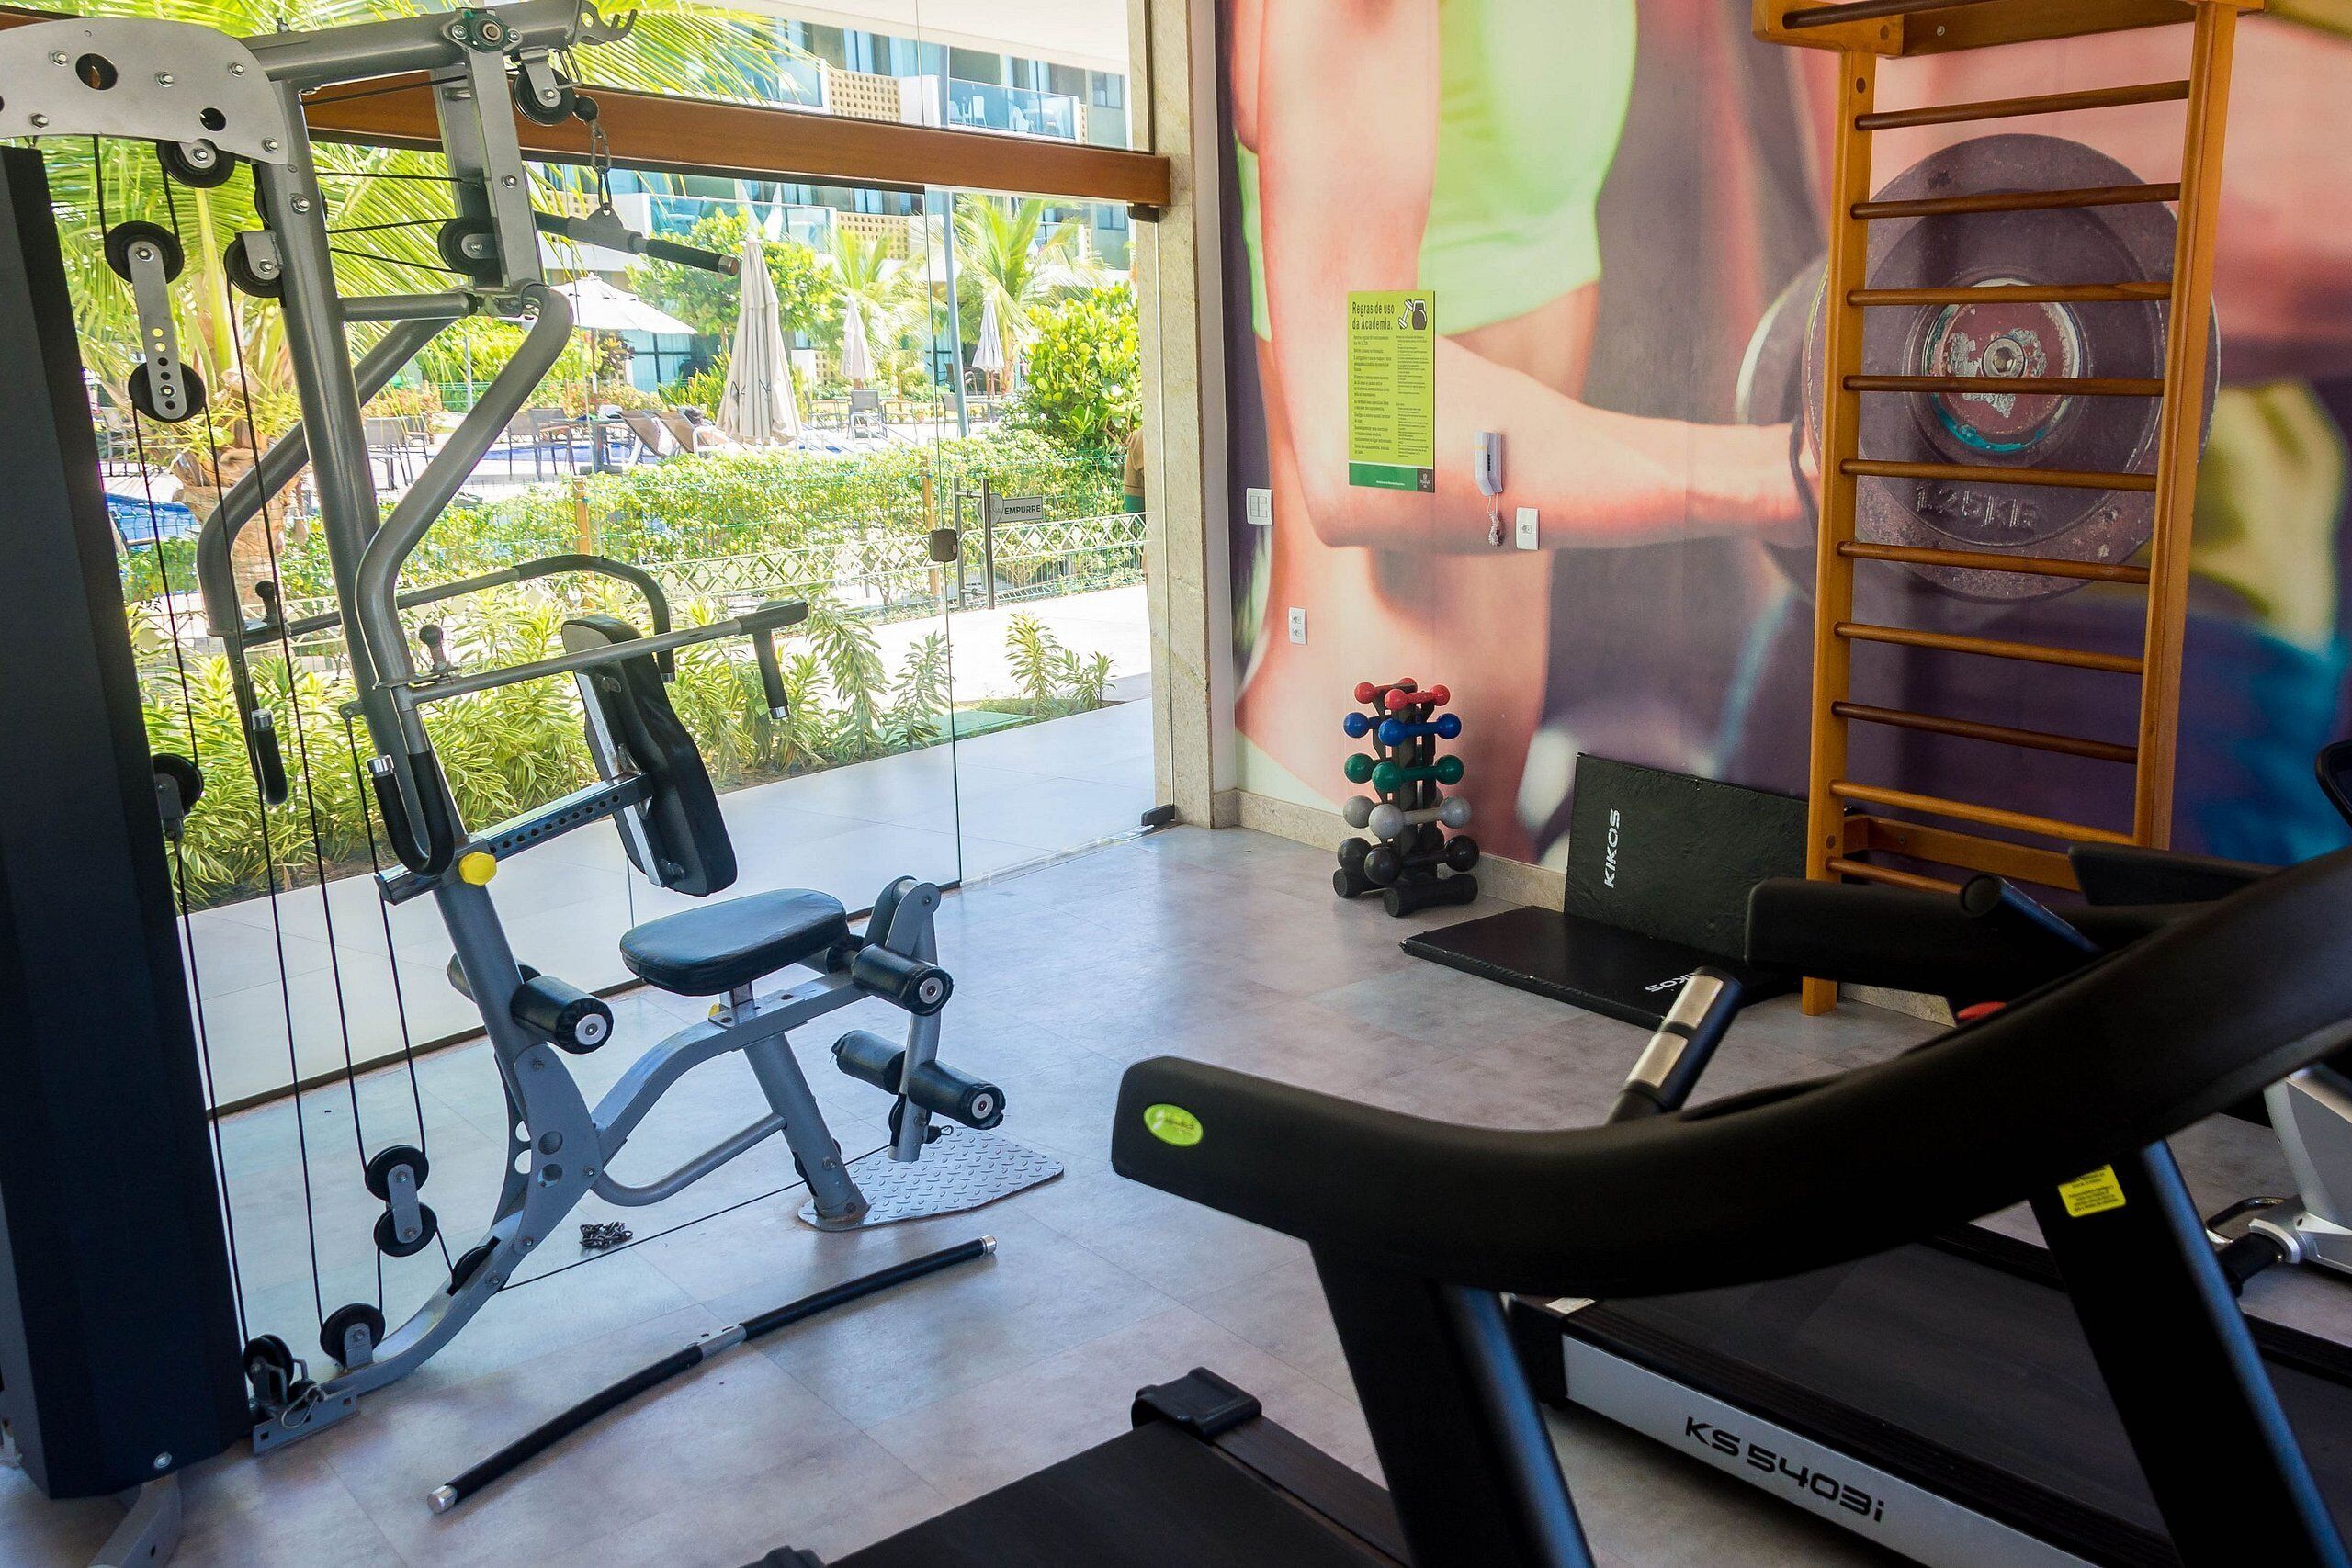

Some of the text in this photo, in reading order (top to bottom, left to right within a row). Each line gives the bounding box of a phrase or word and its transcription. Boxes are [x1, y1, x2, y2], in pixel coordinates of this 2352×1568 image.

[1352, 302, 1395, 317] Regras de uso
[1352, 317, 1360, 330] da
[1004, 504, 1041, 515] EMPURRE
[1604, 807, 1620, 888] KIKOS
[1645, 972, 1695, 992] IKOS
[1685, 1416, 1885, 1523] KS 5403i
